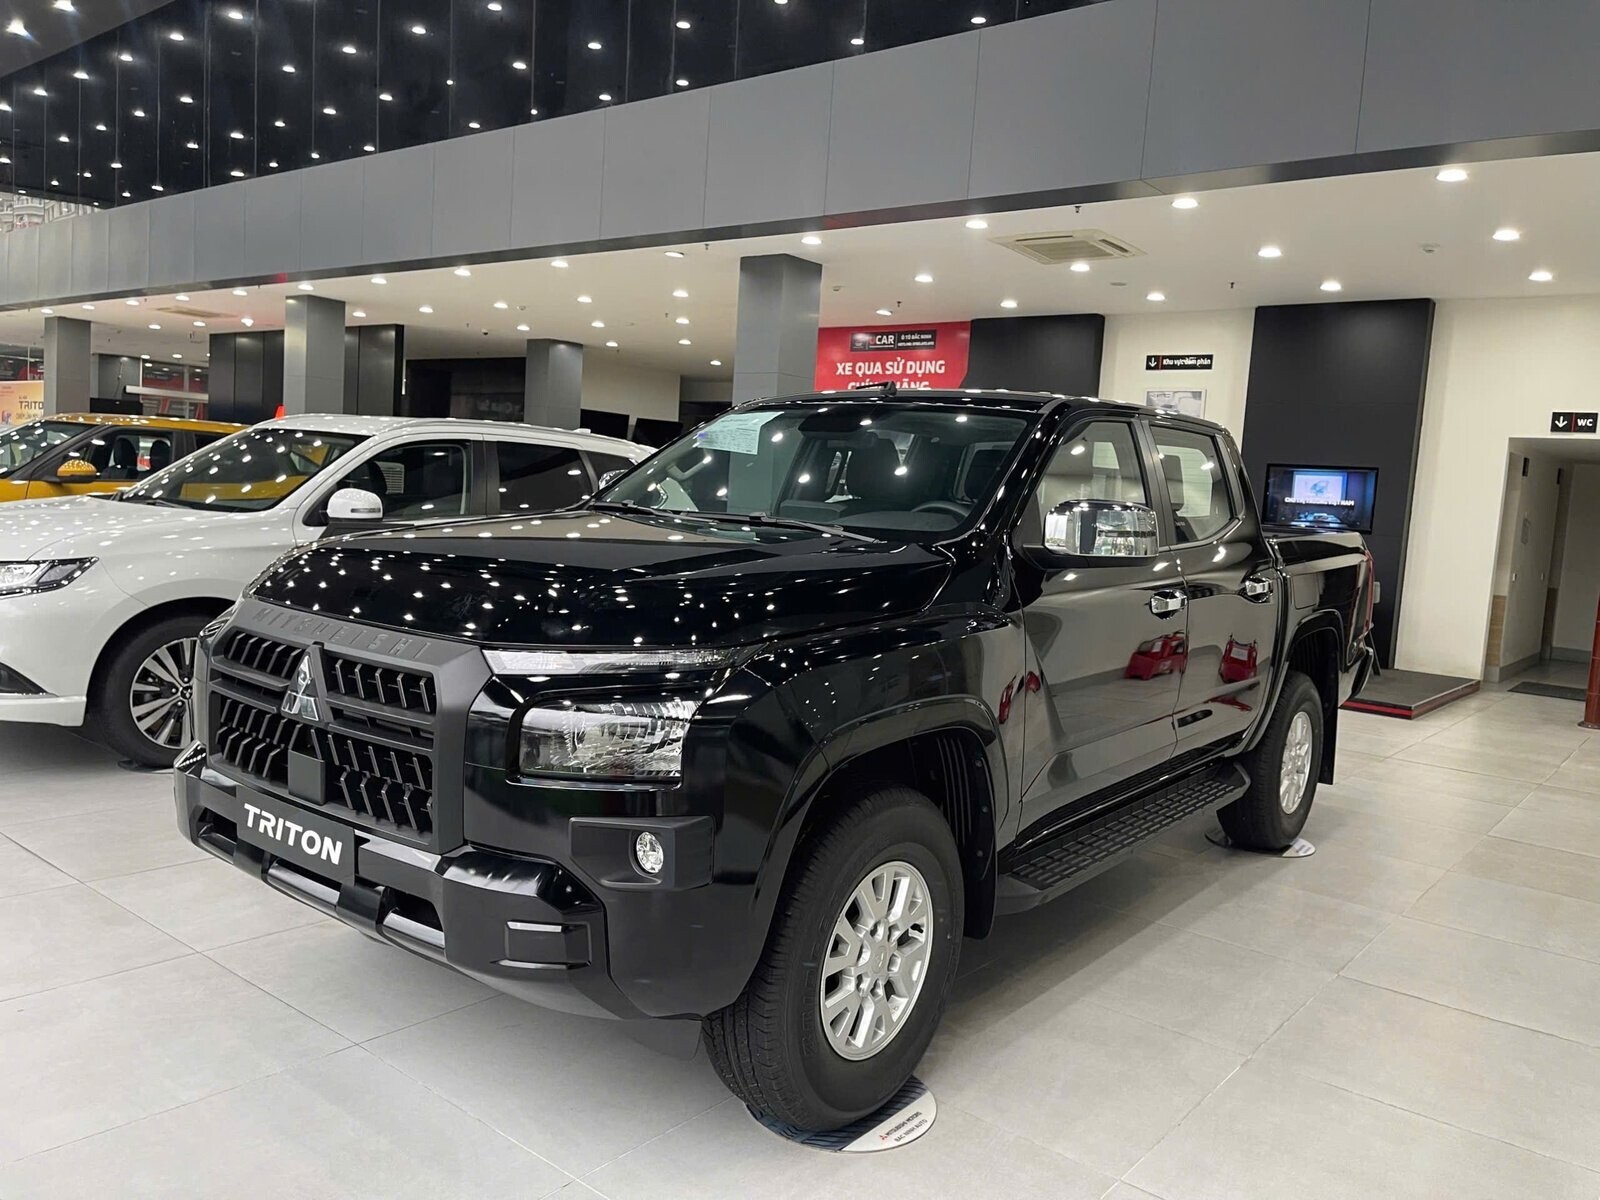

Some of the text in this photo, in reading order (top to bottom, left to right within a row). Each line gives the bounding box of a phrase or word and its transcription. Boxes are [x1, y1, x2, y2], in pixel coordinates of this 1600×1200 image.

[836, 357, 946, 378] XE QUA SỬ DỤNG
[1577, 418, 1593, 427] WC
[253, 607, 431, 659] MITSUBISHI
[244, 802, 343, 865] TRITON
